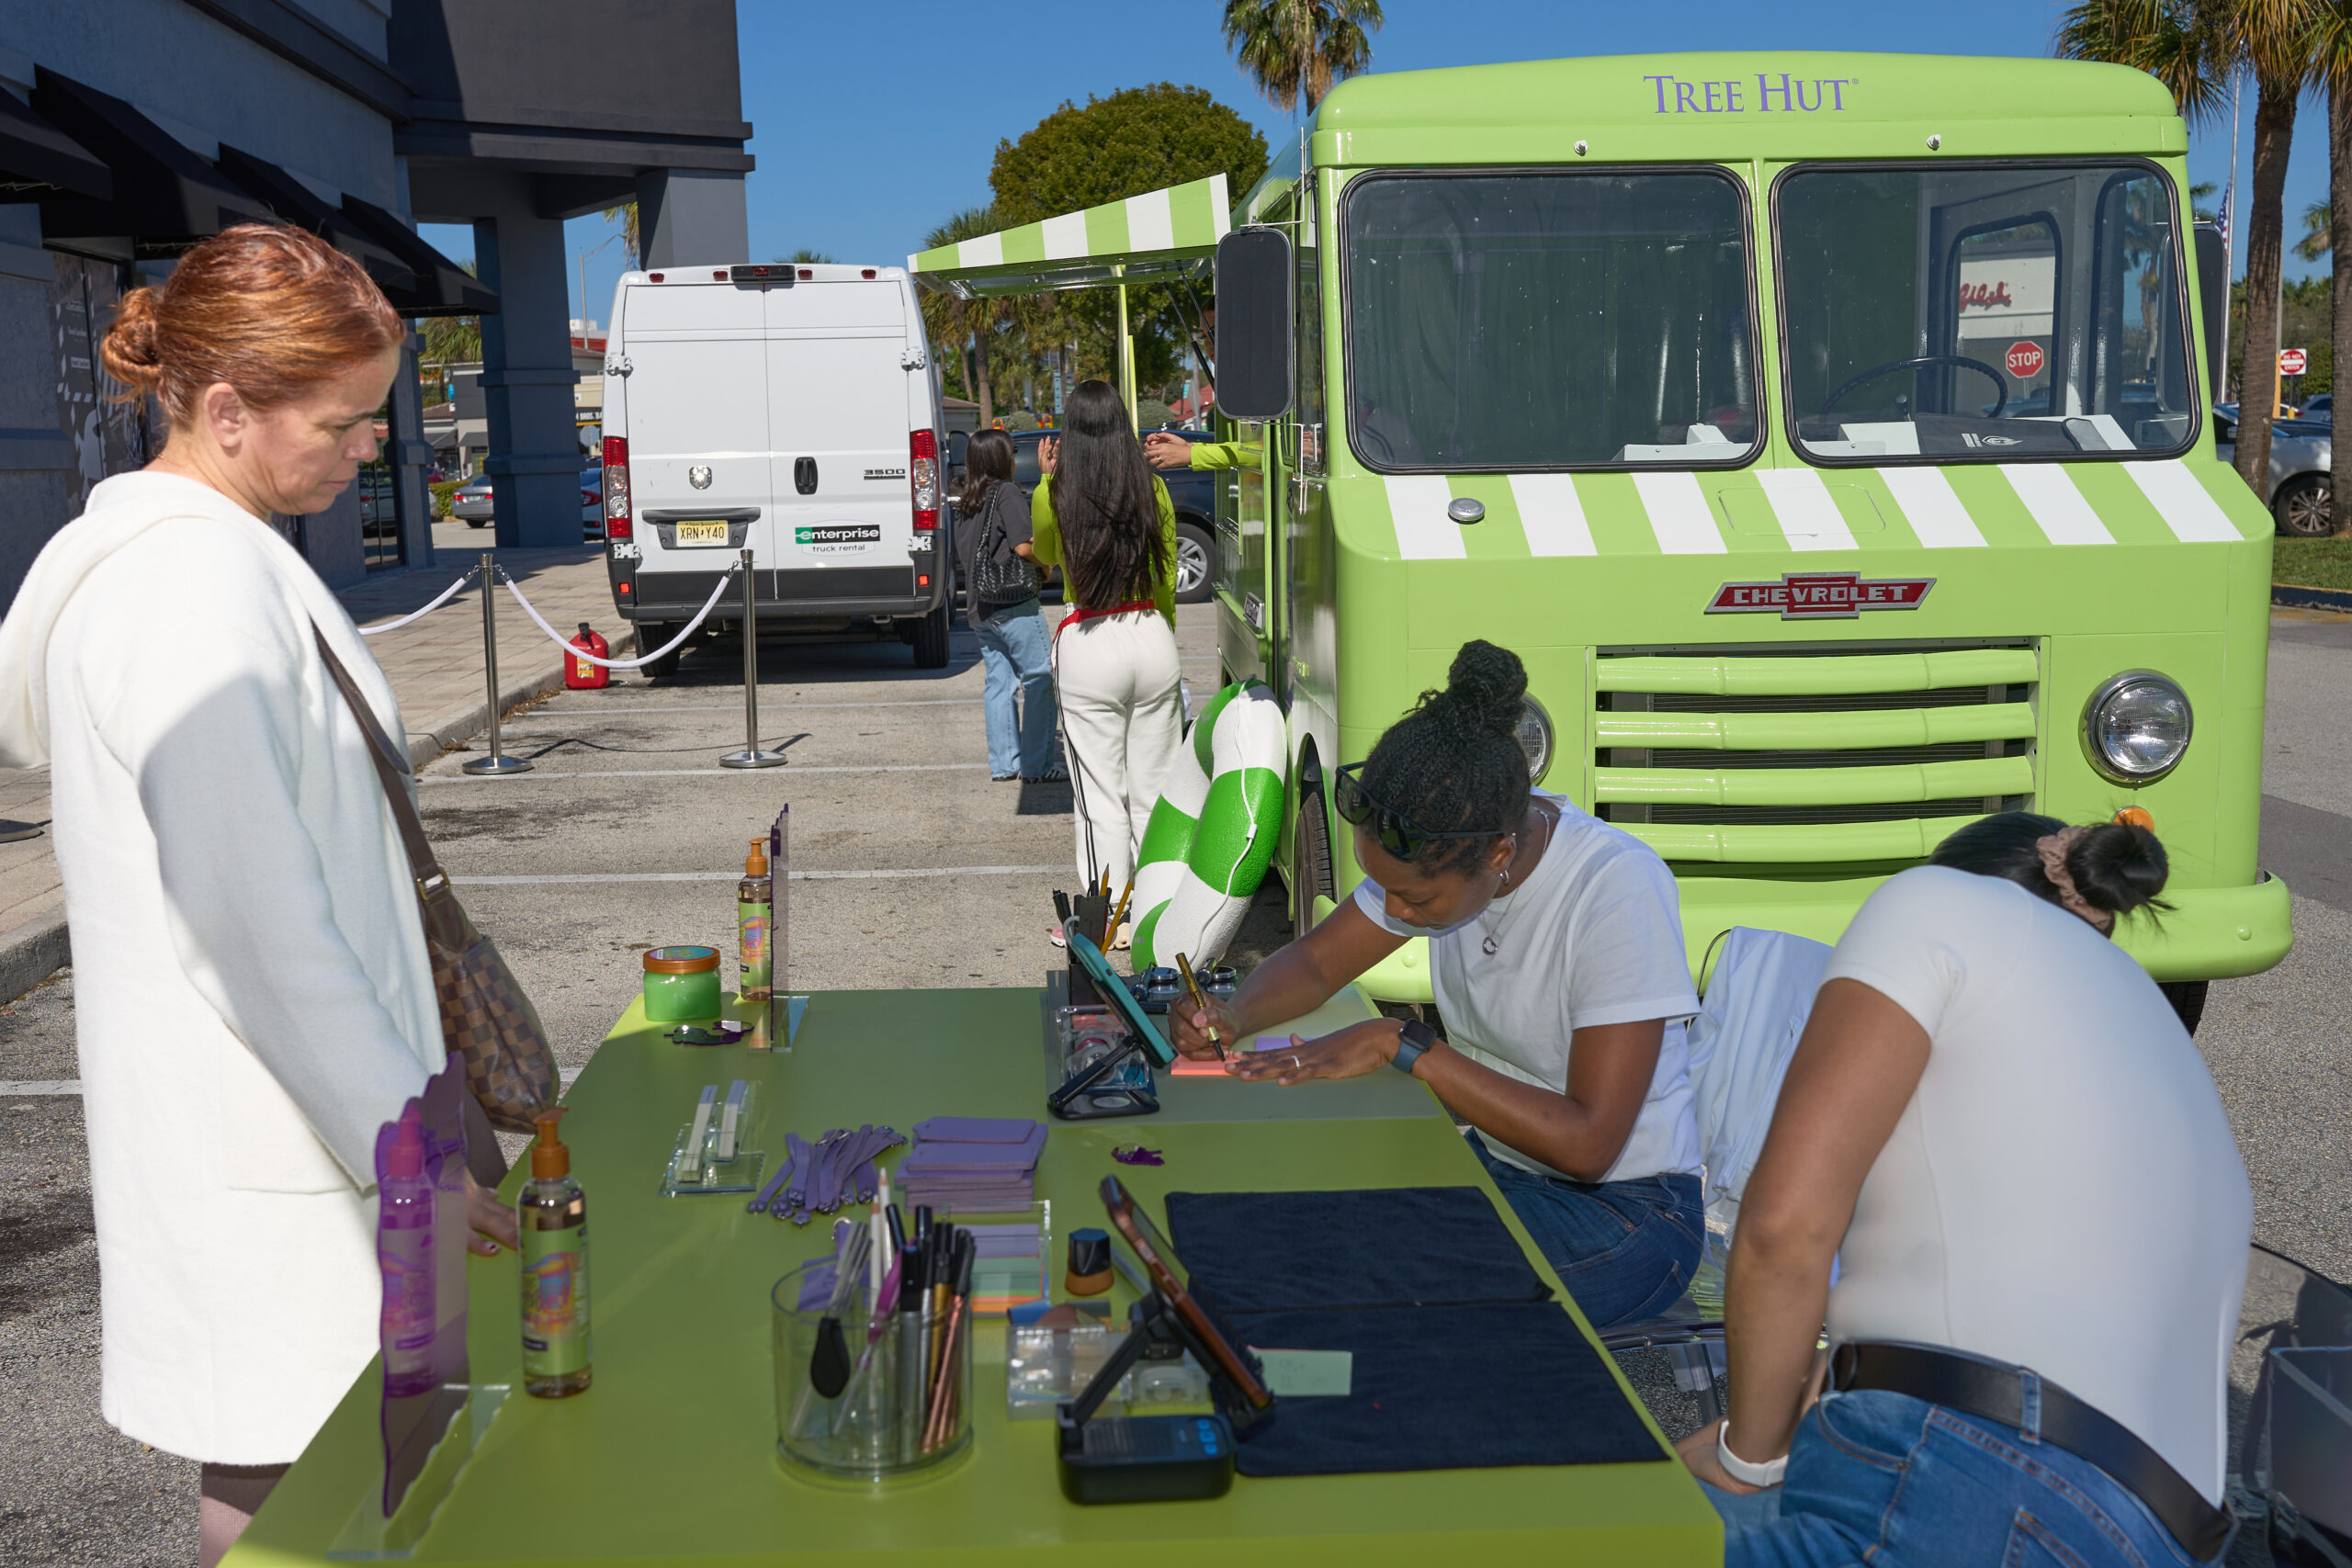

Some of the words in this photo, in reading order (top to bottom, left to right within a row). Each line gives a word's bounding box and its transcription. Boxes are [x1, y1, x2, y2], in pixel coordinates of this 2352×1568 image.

[2008, 351, 2041, 368] STOP
[796, 527, 879, 541] enterprise
[1734, 586, 1908, 604] CHEVROLET
